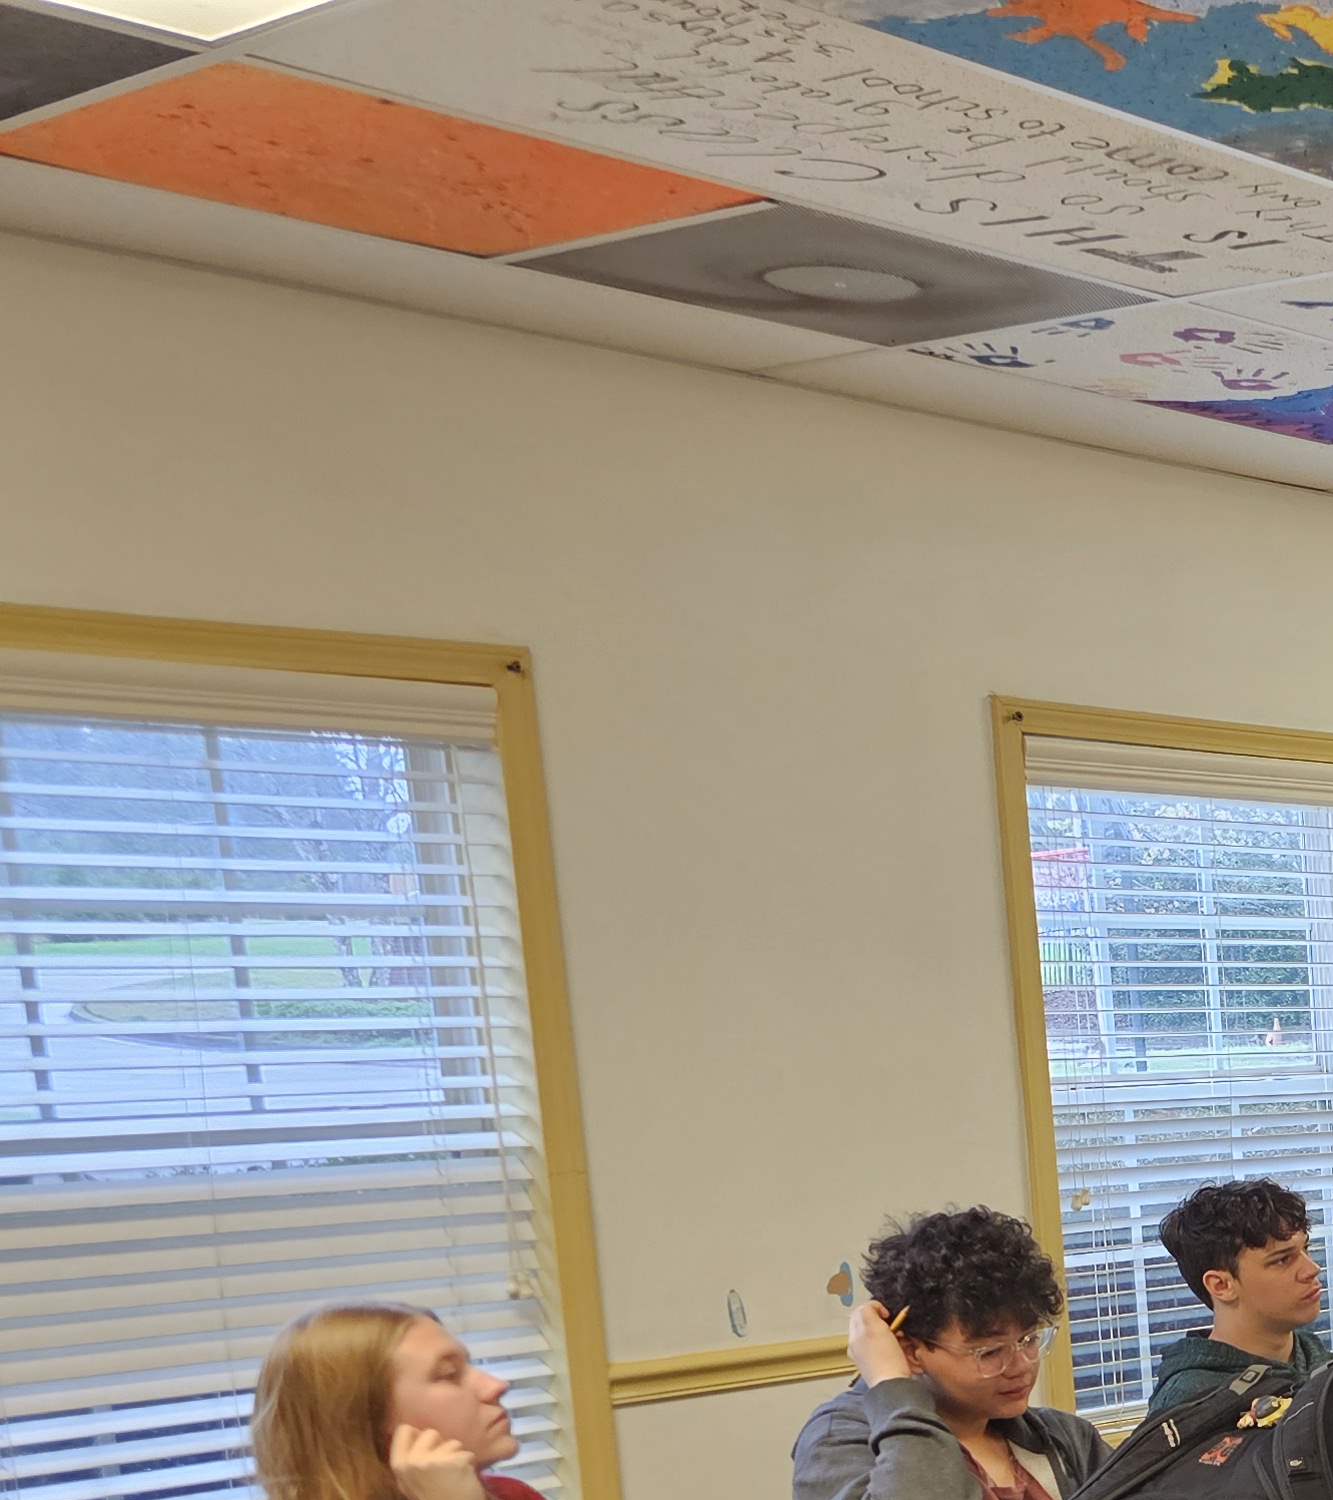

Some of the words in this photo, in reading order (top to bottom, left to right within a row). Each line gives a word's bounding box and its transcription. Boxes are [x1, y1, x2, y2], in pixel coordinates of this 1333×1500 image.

[653, 49, 914, 117] grateful
[820, 67, 1009, 121] school
[556, 99, 887, 182] Class
[946, 124, 1016, 152] be
[1018, 118, 1066, 139] to
[1025, 155, 1218, 204] should
[1069, 135, 1230, 182] come
[913, 196, 1208, 274] THIS
[1182, 229, 1288, 251] IS
